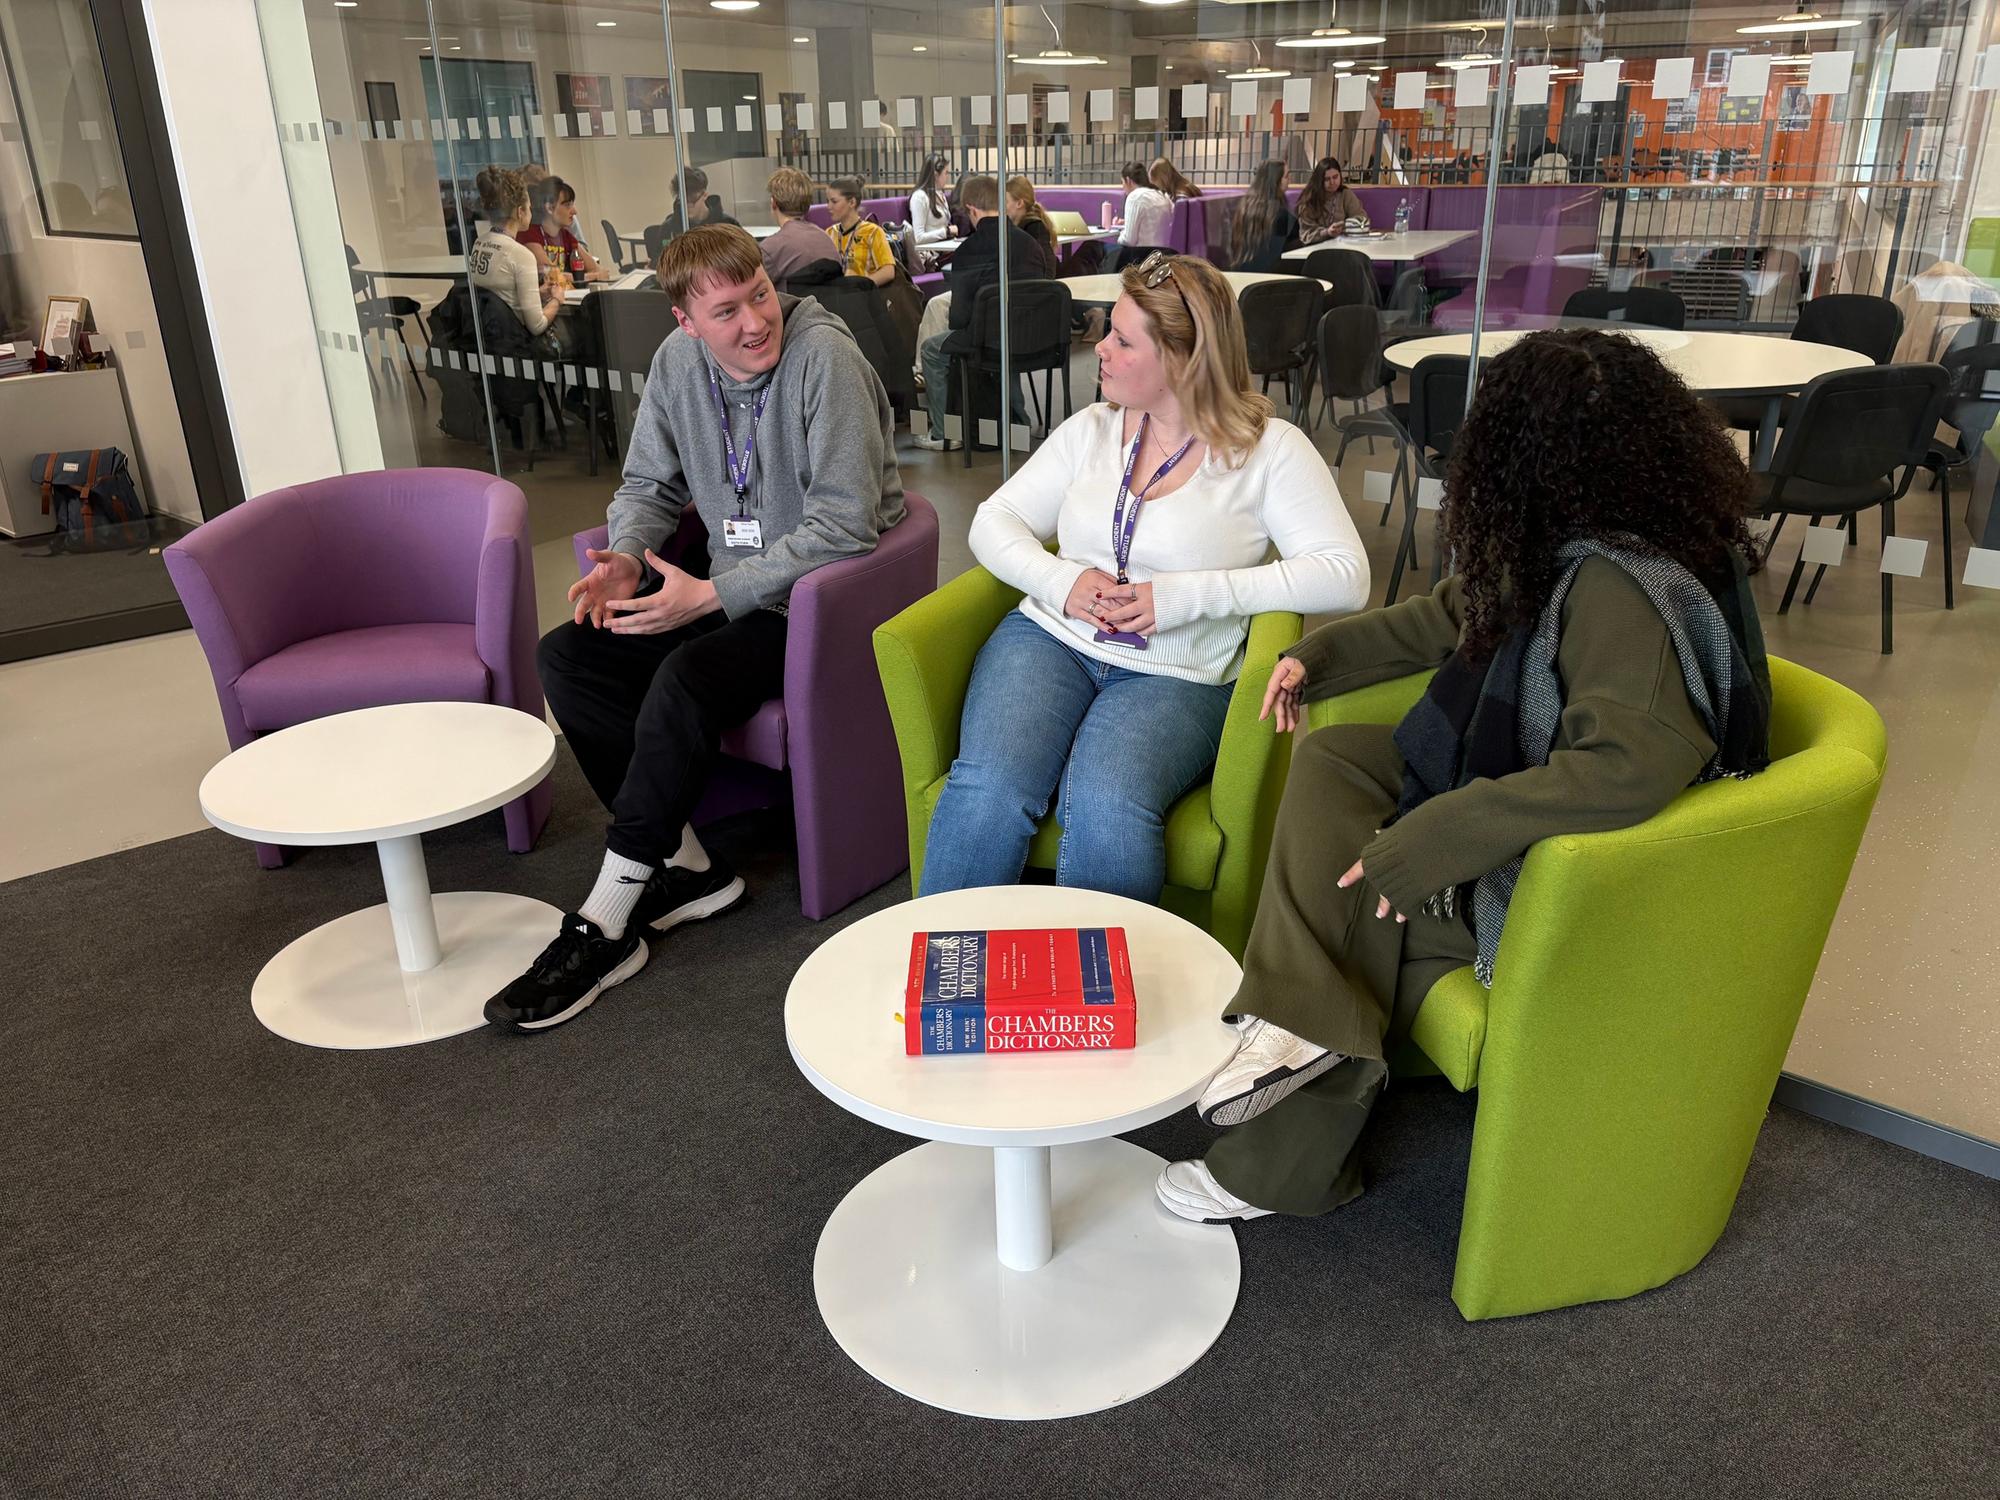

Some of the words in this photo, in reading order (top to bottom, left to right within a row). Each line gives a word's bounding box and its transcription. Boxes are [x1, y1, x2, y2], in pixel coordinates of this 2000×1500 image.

[470, 249, 493, 275] 45
[759, 385, 769, 408] TUDENT
[741, 449, 750, 474] STUDENT
[1125, 452, 1136, 476] STUDENT
[1116, 485, 1127, 511] STUDENT
[1121, 534, 1131, 563] STUDENT
[938, 936, 960, 999] CHAMBERS
[960, 935, 979, 998] DICTIONARY
[936, 1008, 945, 1051] CHAMBERS
[945, 1008, 953, 1051] DICTIONARY
[988, 1015, 1115, 1033] CHAMBERS
[988, 1034, 1116, 1049] DICTIONARY
